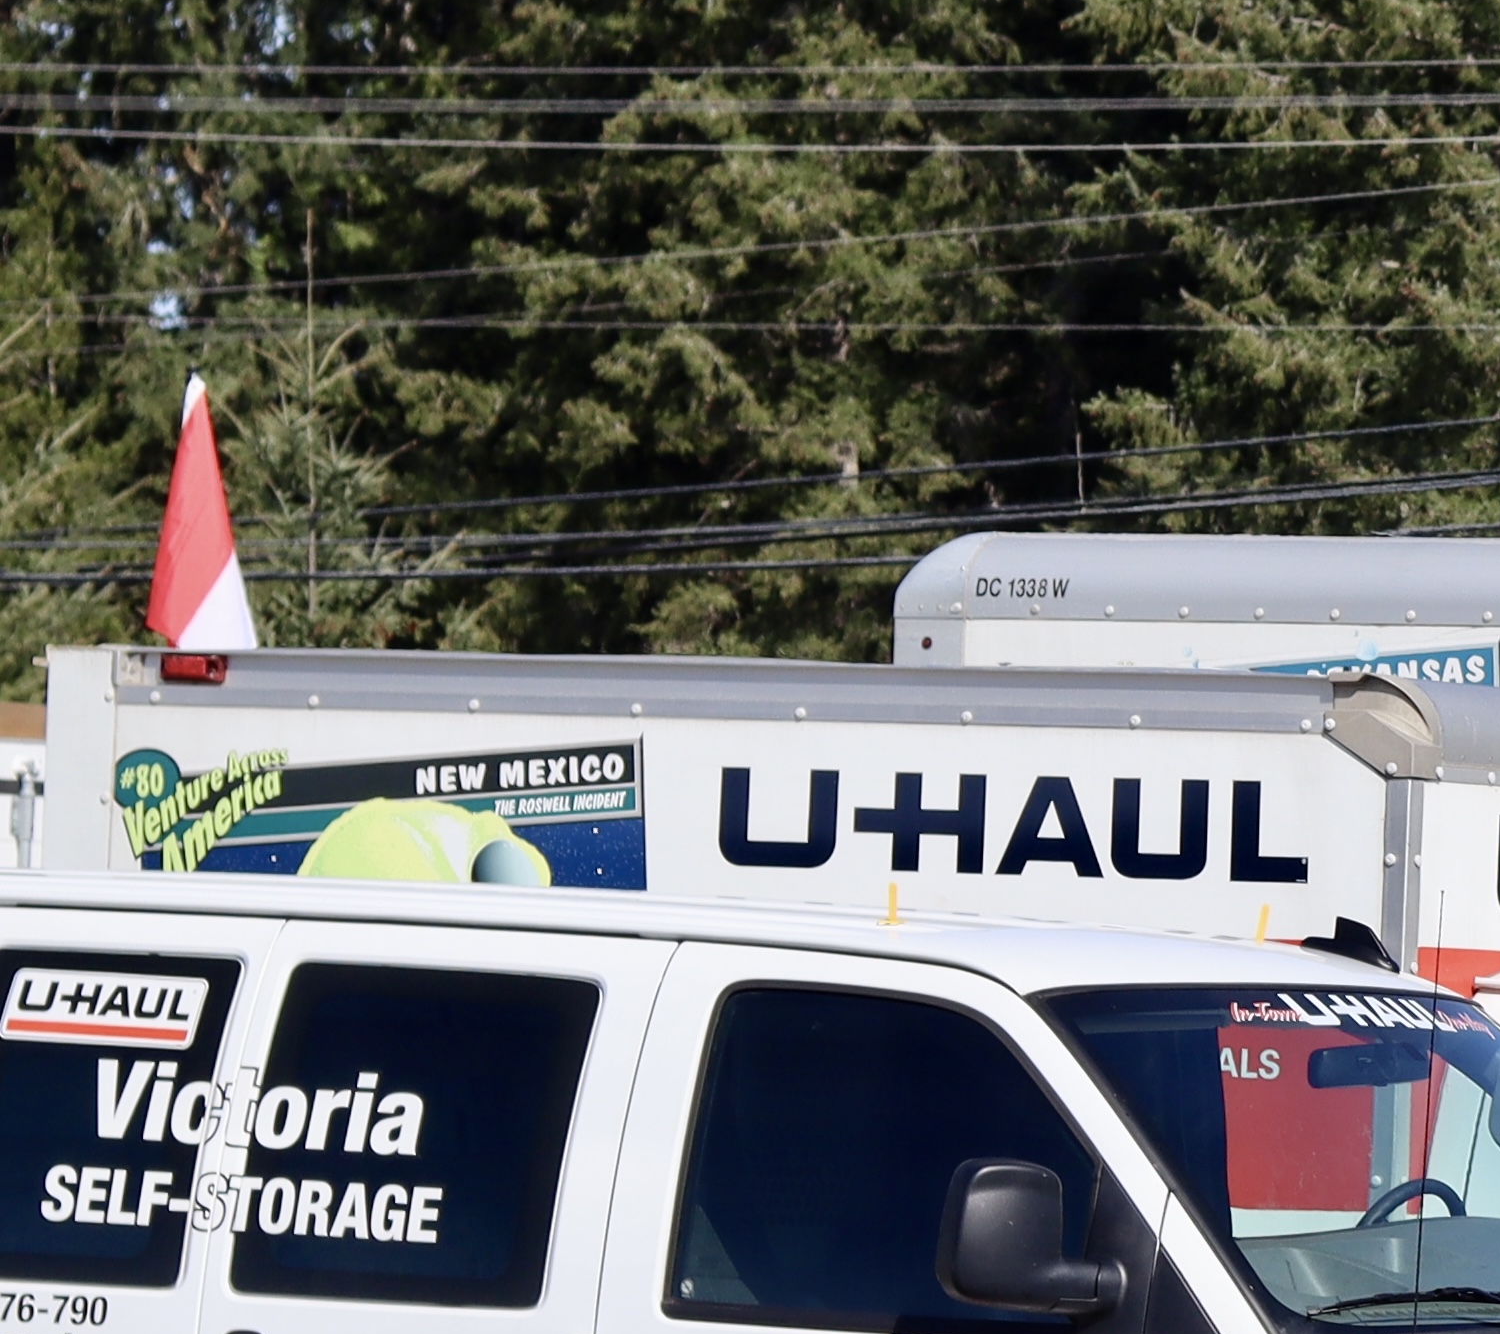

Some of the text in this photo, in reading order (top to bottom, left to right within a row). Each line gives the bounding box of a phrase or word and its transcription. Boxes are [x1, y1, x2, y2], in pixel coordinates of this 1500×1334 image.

[976, 578, 1069, 599] DC 1338 W
[119, 762, 165, 798] #80
[415, 752, 625, 796] NEW MEXICO
[123, 748, 289, 859] Venture Across
[161, 770, 283, 872] America
[494, 790, 626, 816] THE ROSWELL INCIDENT
[718, 767, 1308, 884] U-HAUL
[17, 980, 189, 1021] U-HAUL
[97, 1058, 424, 1156] Victoria
[40, 1164, 443, 1244] SELF-STORAGE
[0, 1293, 108, 1326] 76-790
